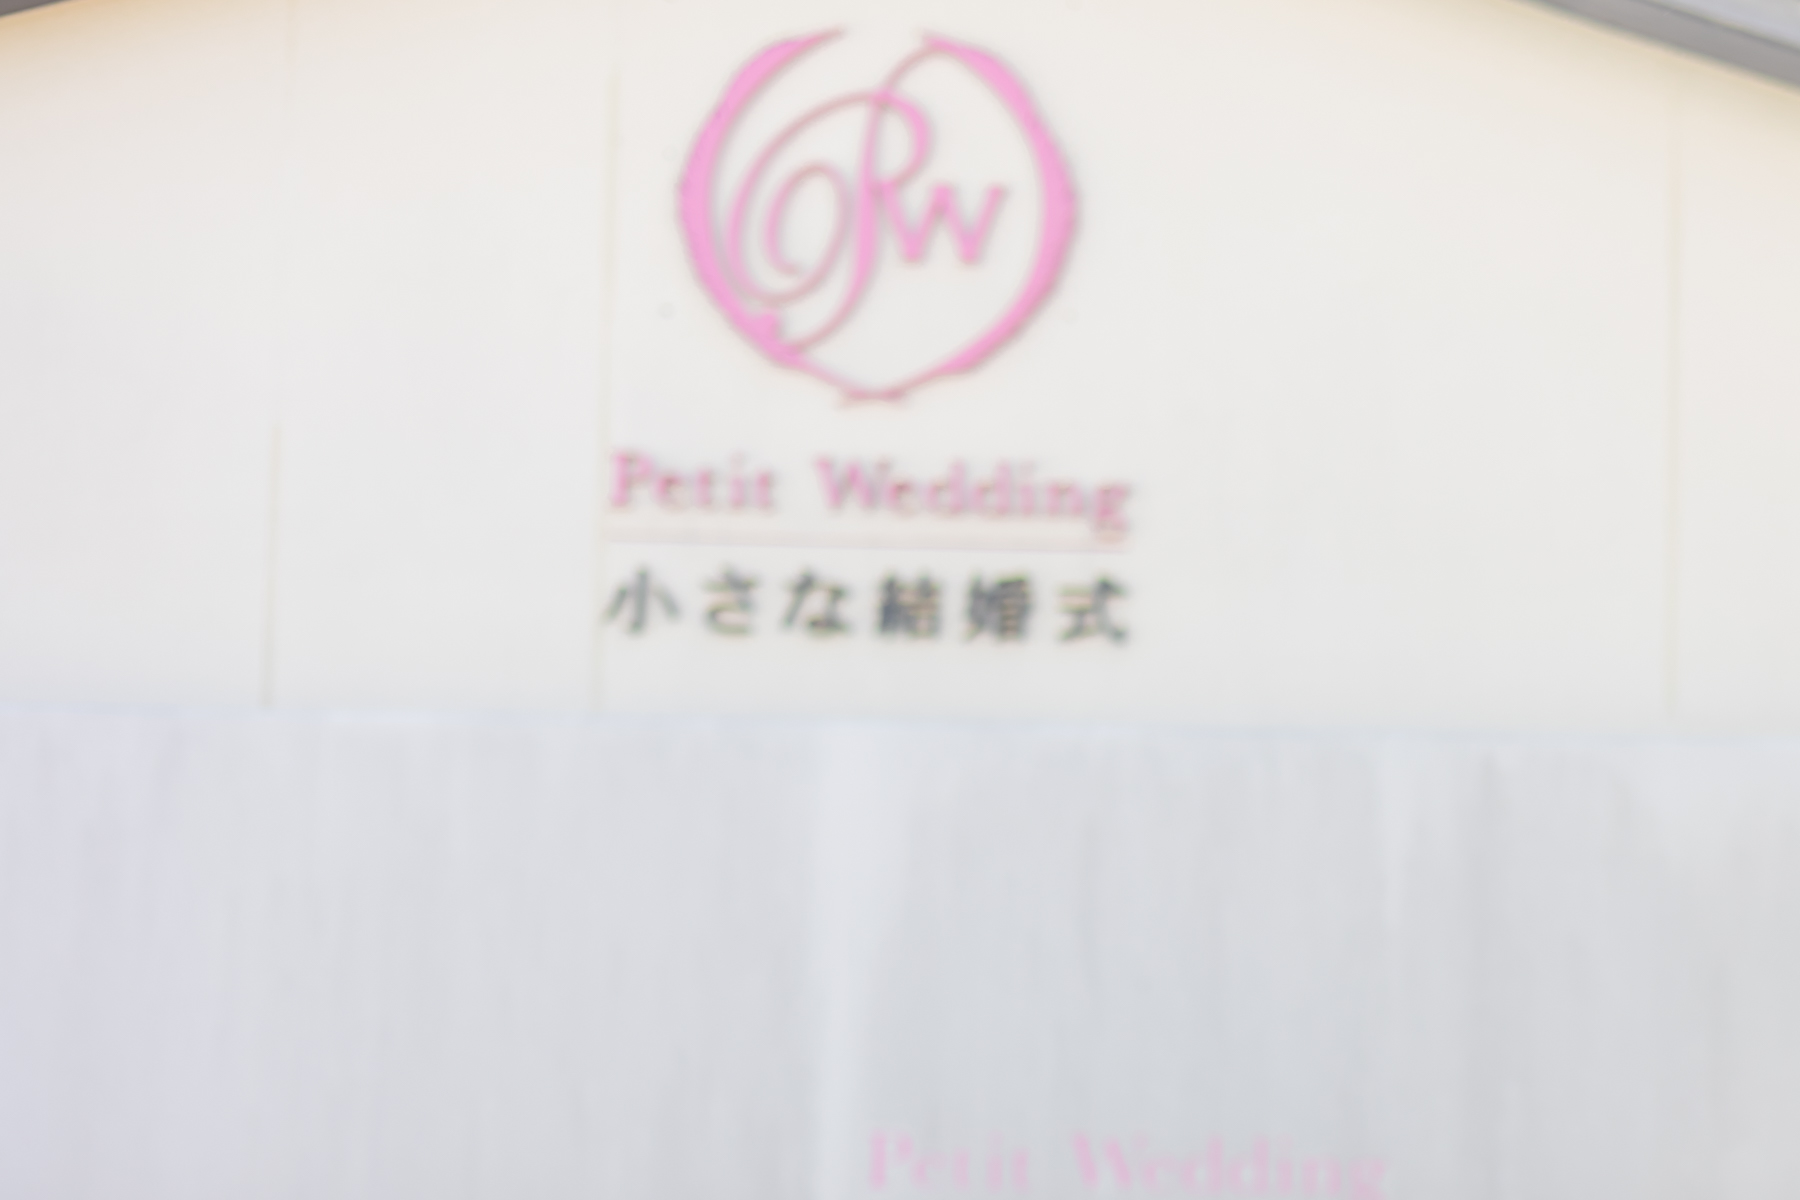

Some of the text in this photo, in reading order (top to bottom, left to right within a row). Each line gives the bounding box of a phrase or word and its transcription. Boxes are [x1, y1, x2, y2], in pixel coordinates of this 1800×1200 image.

[609, 450, 1133, 544] Petit Wedding
[604, 566, 1131, 644] 小さな結婚式
[868, 1130, 1033, 1192] Petit
